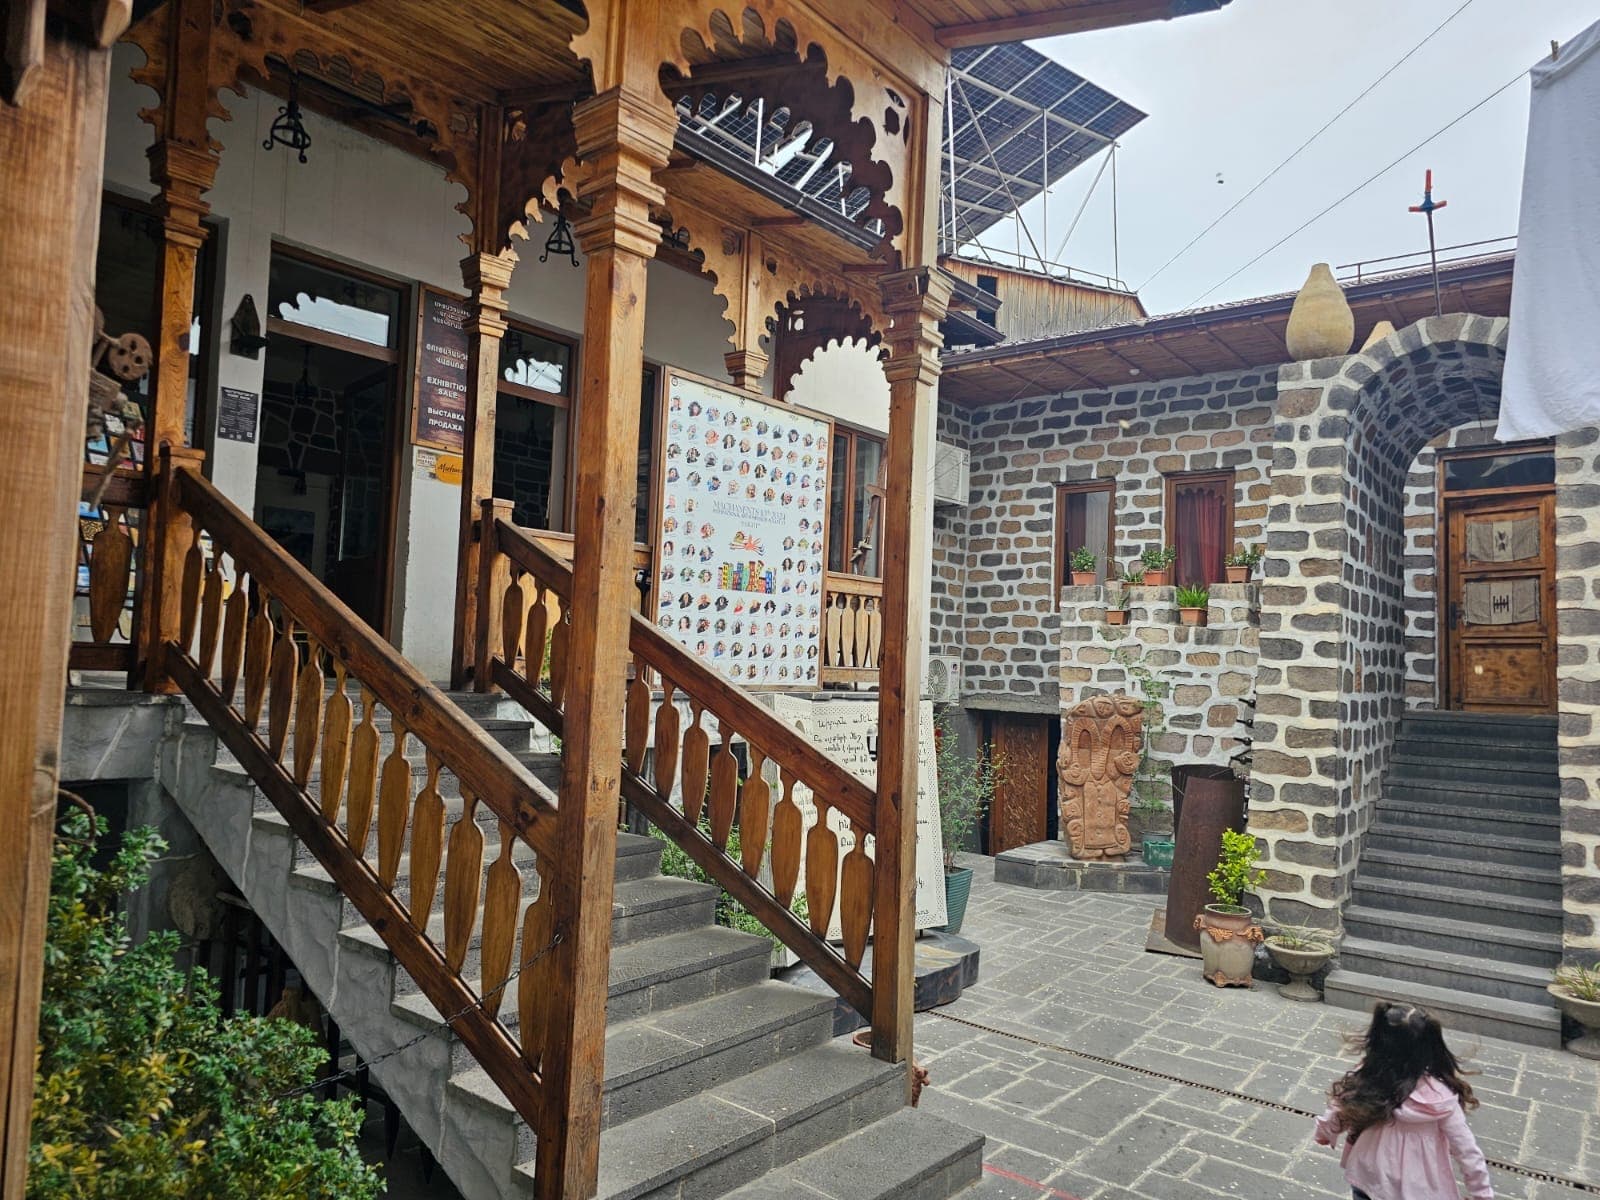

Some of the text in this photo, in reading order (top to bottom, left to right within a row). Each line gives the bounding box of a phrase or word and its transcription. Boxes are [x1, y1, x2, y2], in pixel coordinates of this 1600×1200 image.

[438, 388, 459, 399] SALE
[427, 407, 465, 422] ВЫСТАВКА
[428, 419, 463, 432] ПРОДАЖА
